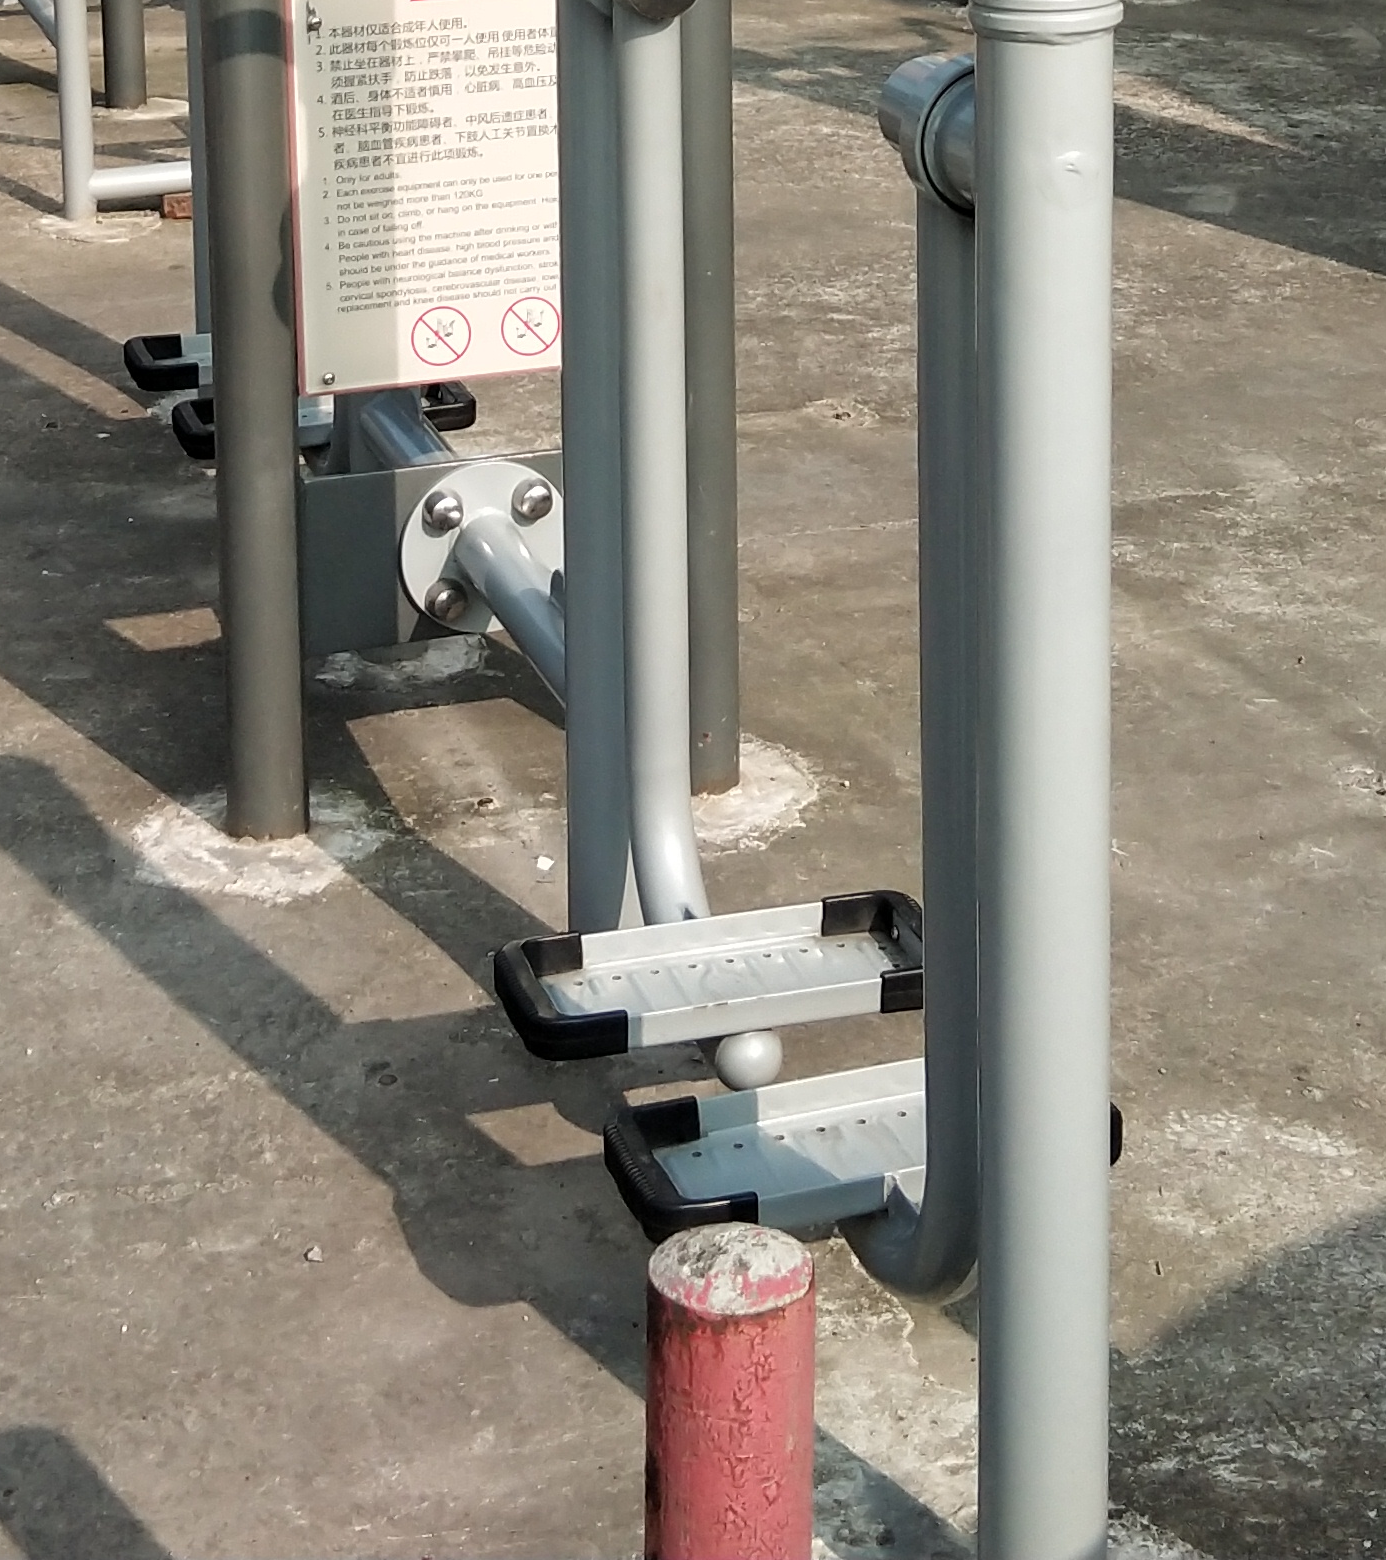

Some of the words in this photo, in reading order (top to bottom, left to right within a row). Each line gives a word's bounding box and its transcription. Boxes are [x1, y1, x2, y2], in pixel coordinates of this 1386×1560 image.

[492, 174, 512, 183] used
[353, 200, 364, 209] be
[406, 195, 428, 203] more
[431, 193, 450, 202] than
[337, 215, 350, 224] Do
[353, 214, 366, 222] not
[438, 205, 459, 214] hang
[462, 204, 472, 212] on
[475, 203, 488, 211] the
[348, 227, 369, 236] case
[419, 233, 432, 241] the
[434, 231, 471, 240] machine
[474, 228, 493, 236] after
[339, 253, 369, 263] People
[393, 248, 414, 257] heart
[456, 242, 474, 252] high
[477, 239, 500, 248] blood
[503, 237, 541, 247] pressure
[339, 267, 368, 276] should
[371, 264, 382, 273] be
[384, 262, 409, 271] under
[412, 260, 426, 268] the
[470, 254, 480, 262] of
[481, 251, 514, 261] medical
[340, 280, 370, 290] People
[448, 268, 482, 278] balance
[337, 300, 392, 313] replacement
[394, 298, 410, 307] and
[437, 293, 470, 303] disease
[473, 289, 501, 299] should
